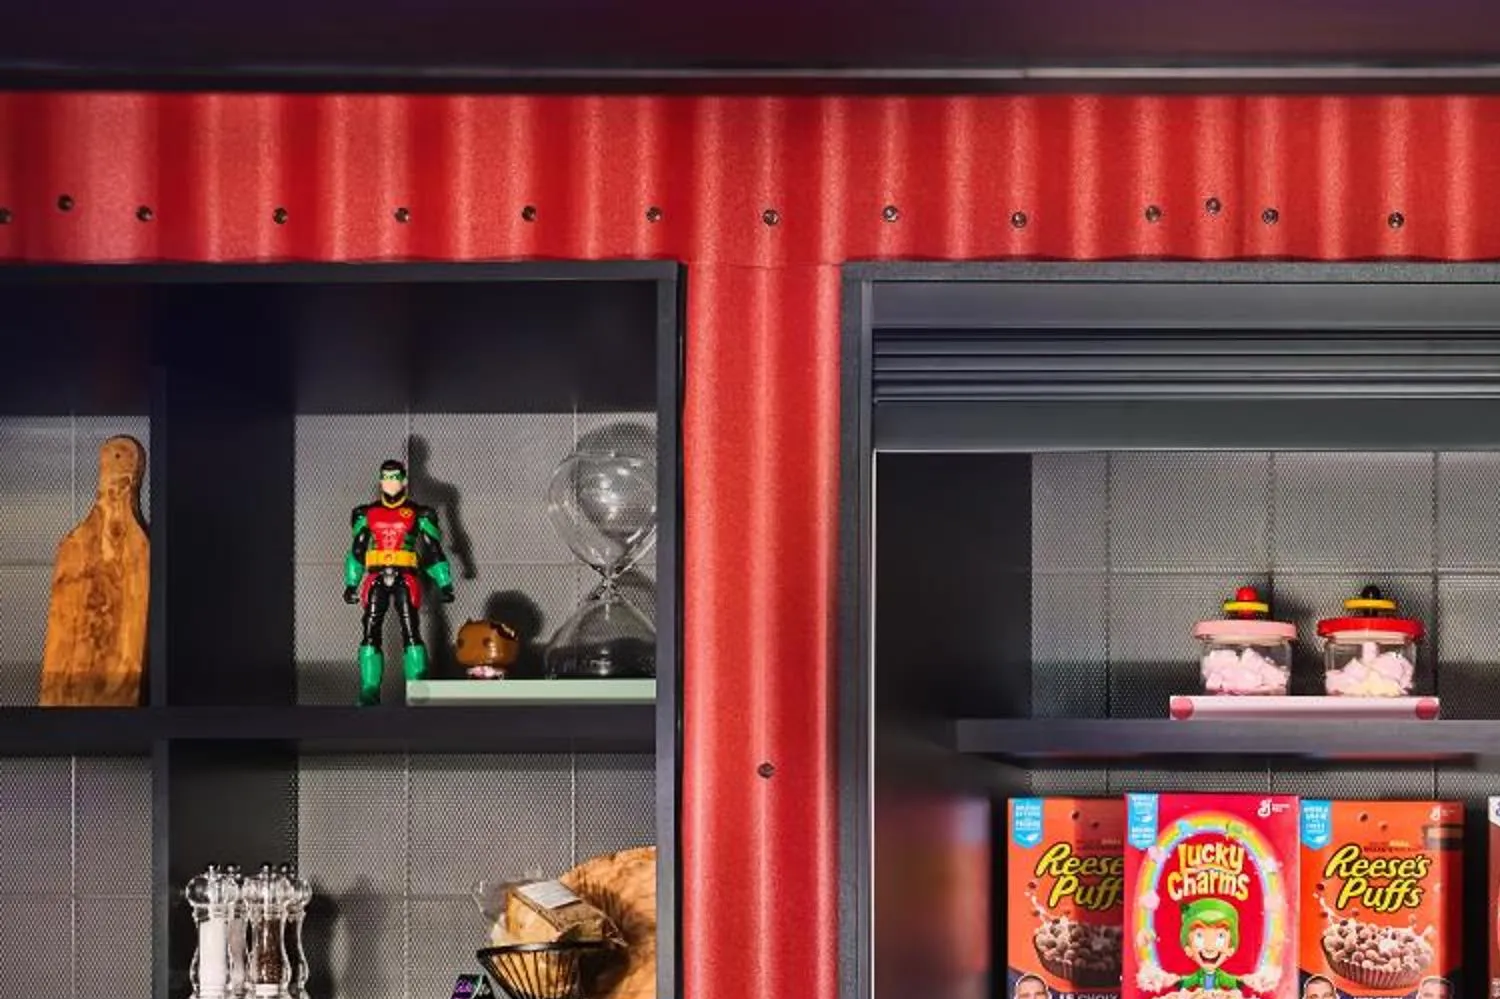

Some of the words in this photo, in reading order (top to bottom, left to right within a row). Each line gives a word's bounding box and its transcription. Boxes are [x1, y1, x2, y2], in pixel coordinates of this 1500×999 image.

[1034, 841, 1124, 878] Reese
[1178, 842, 1245, 875] Lucky
[1324, 843, 1431, 878] Reese's
[1167, 870, 1250, 901] Charms
[1336, 876, 1425, 912] Puffs
